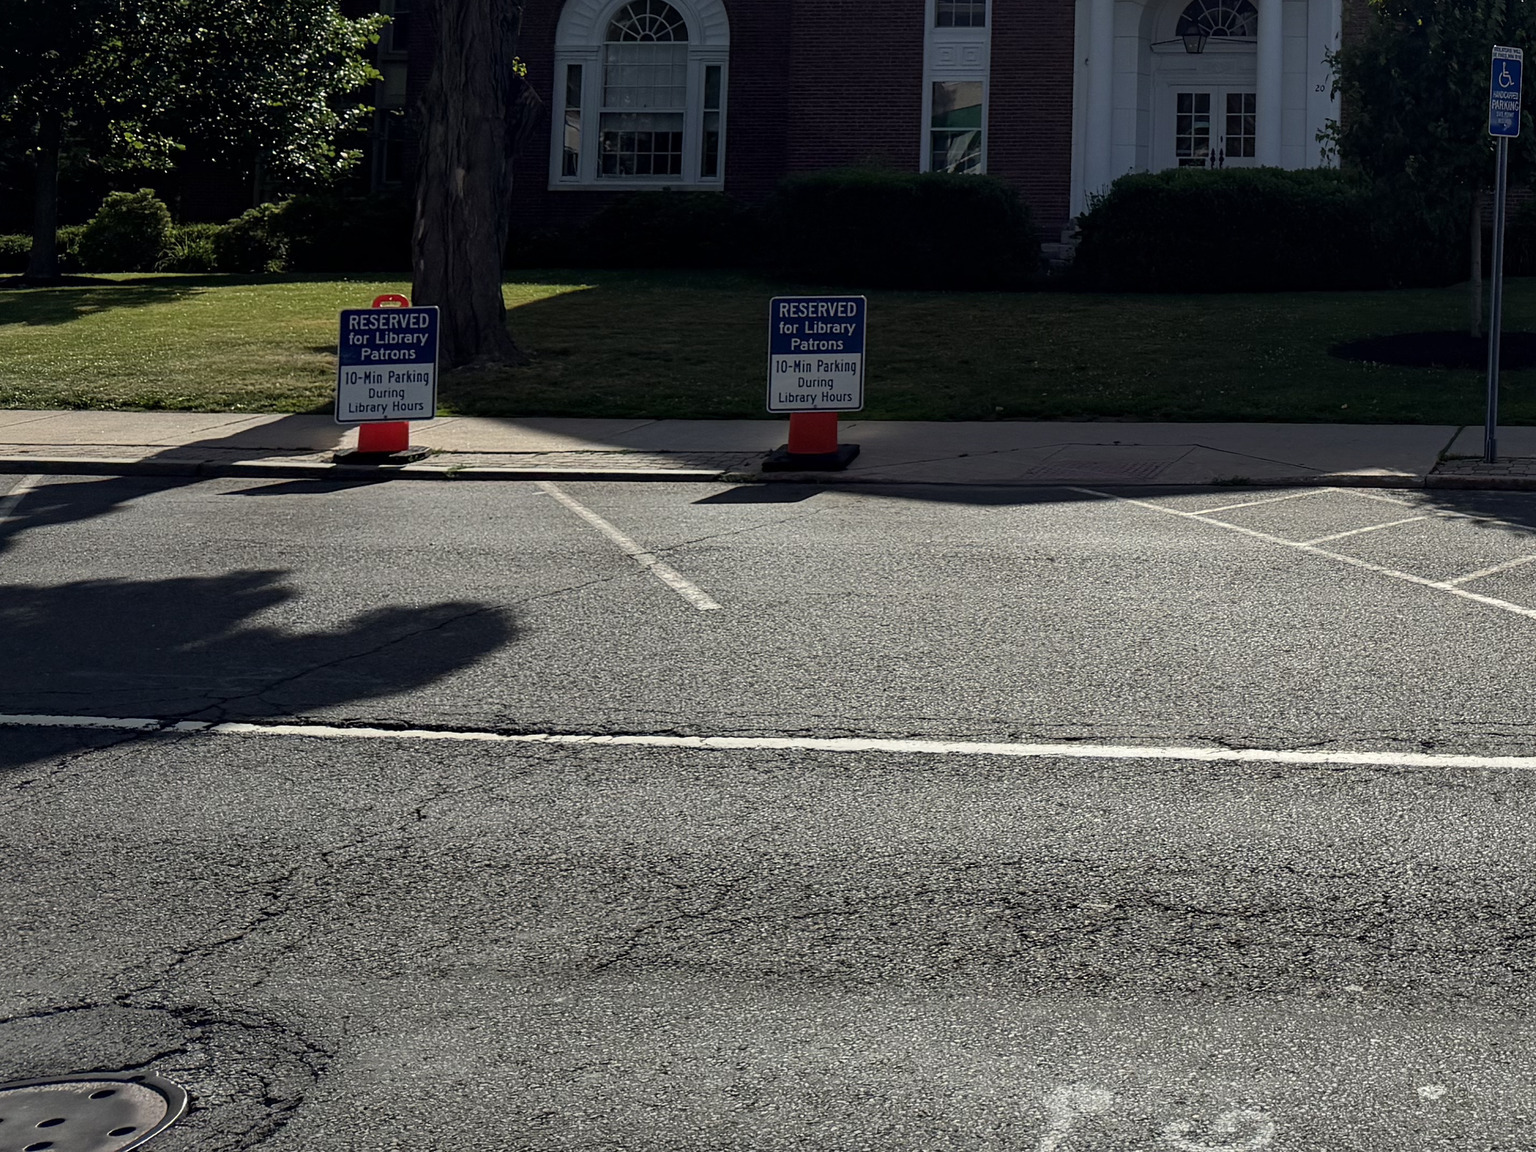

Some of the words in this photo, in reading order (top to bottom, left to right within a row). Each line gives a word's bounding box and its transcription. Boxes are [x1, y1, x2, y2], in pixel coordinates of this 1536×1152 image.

[1491, 100, 1519, 112] PARKING
[779, 302, 857, 318] RESERVED
[349, 313, 429, 330] RESERVED
[779, 322, 799, 334] for
[805, 321, 856, 336] Library
[349, 332, 369, 345] for
[376, 332, 428, 345] Library
[791, 338, 843, 351] Patrons
[361, 348, 416, 360] Patrons
[776, 360, 811, 373] 10-Min
[817, 359, 856, 376] Parking
[345, 371, 382, 385] 10-Min
[388, 371, 429, 386] Parking
[798, 377, 833, 390] During
[368, 388, 405, 400] During
[778, 392, 817, 404] Library
[822, 391, 852, 402] Hours
[349, 402, 387, 414] Library
[393, 401, 424, 412] Hours
